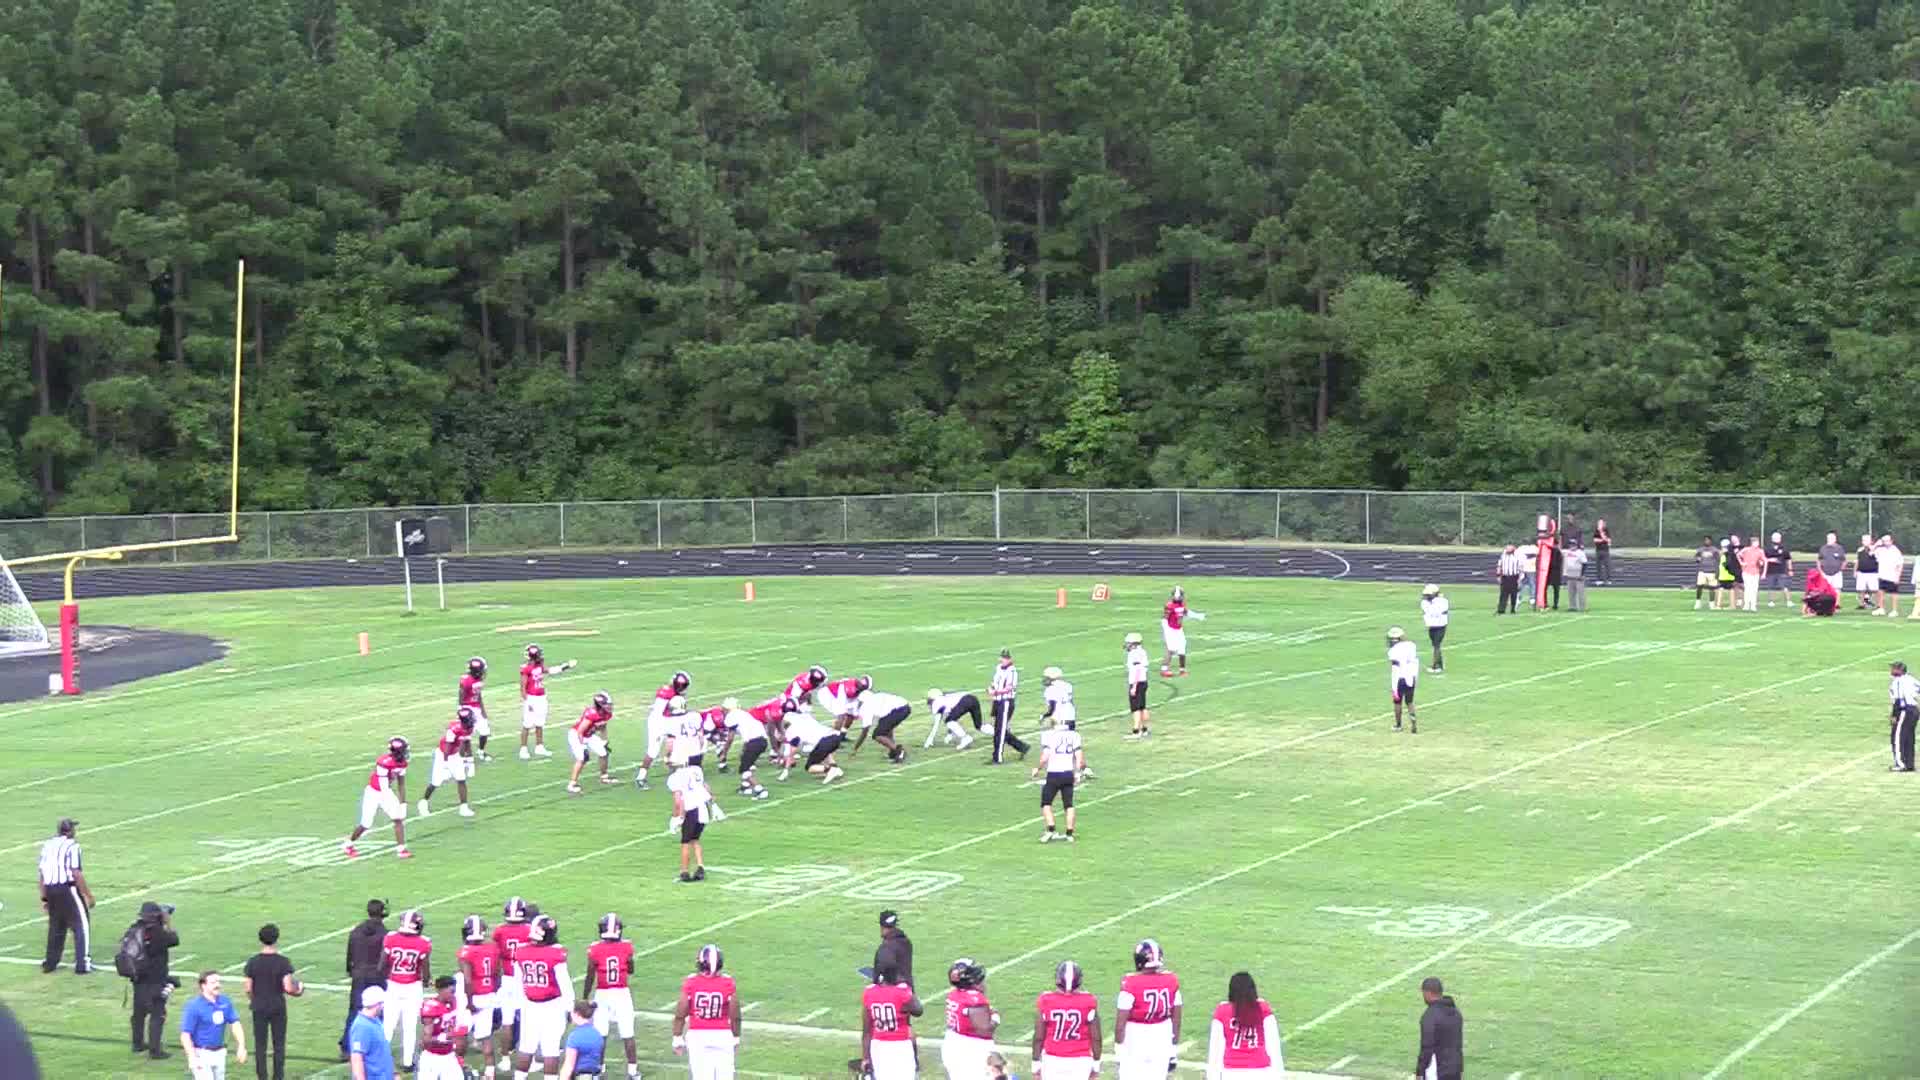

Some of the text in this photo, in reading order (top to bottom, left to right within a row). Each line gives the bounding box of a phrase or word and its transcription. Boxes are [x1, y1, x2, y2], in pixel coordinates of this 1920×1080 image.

[390, 946, 420, 974] 23
[482, 956, 492, 987] 1
[521, 960, 549, 988] 66
[606, 955, 620, 984] 6
[694, 991, 724, 1020] 50
[1143, 987, 1170, 1021] 71
[1049, 1008, 1082, 1041] 72
[1229, 1017, 1259, 1050] 74
